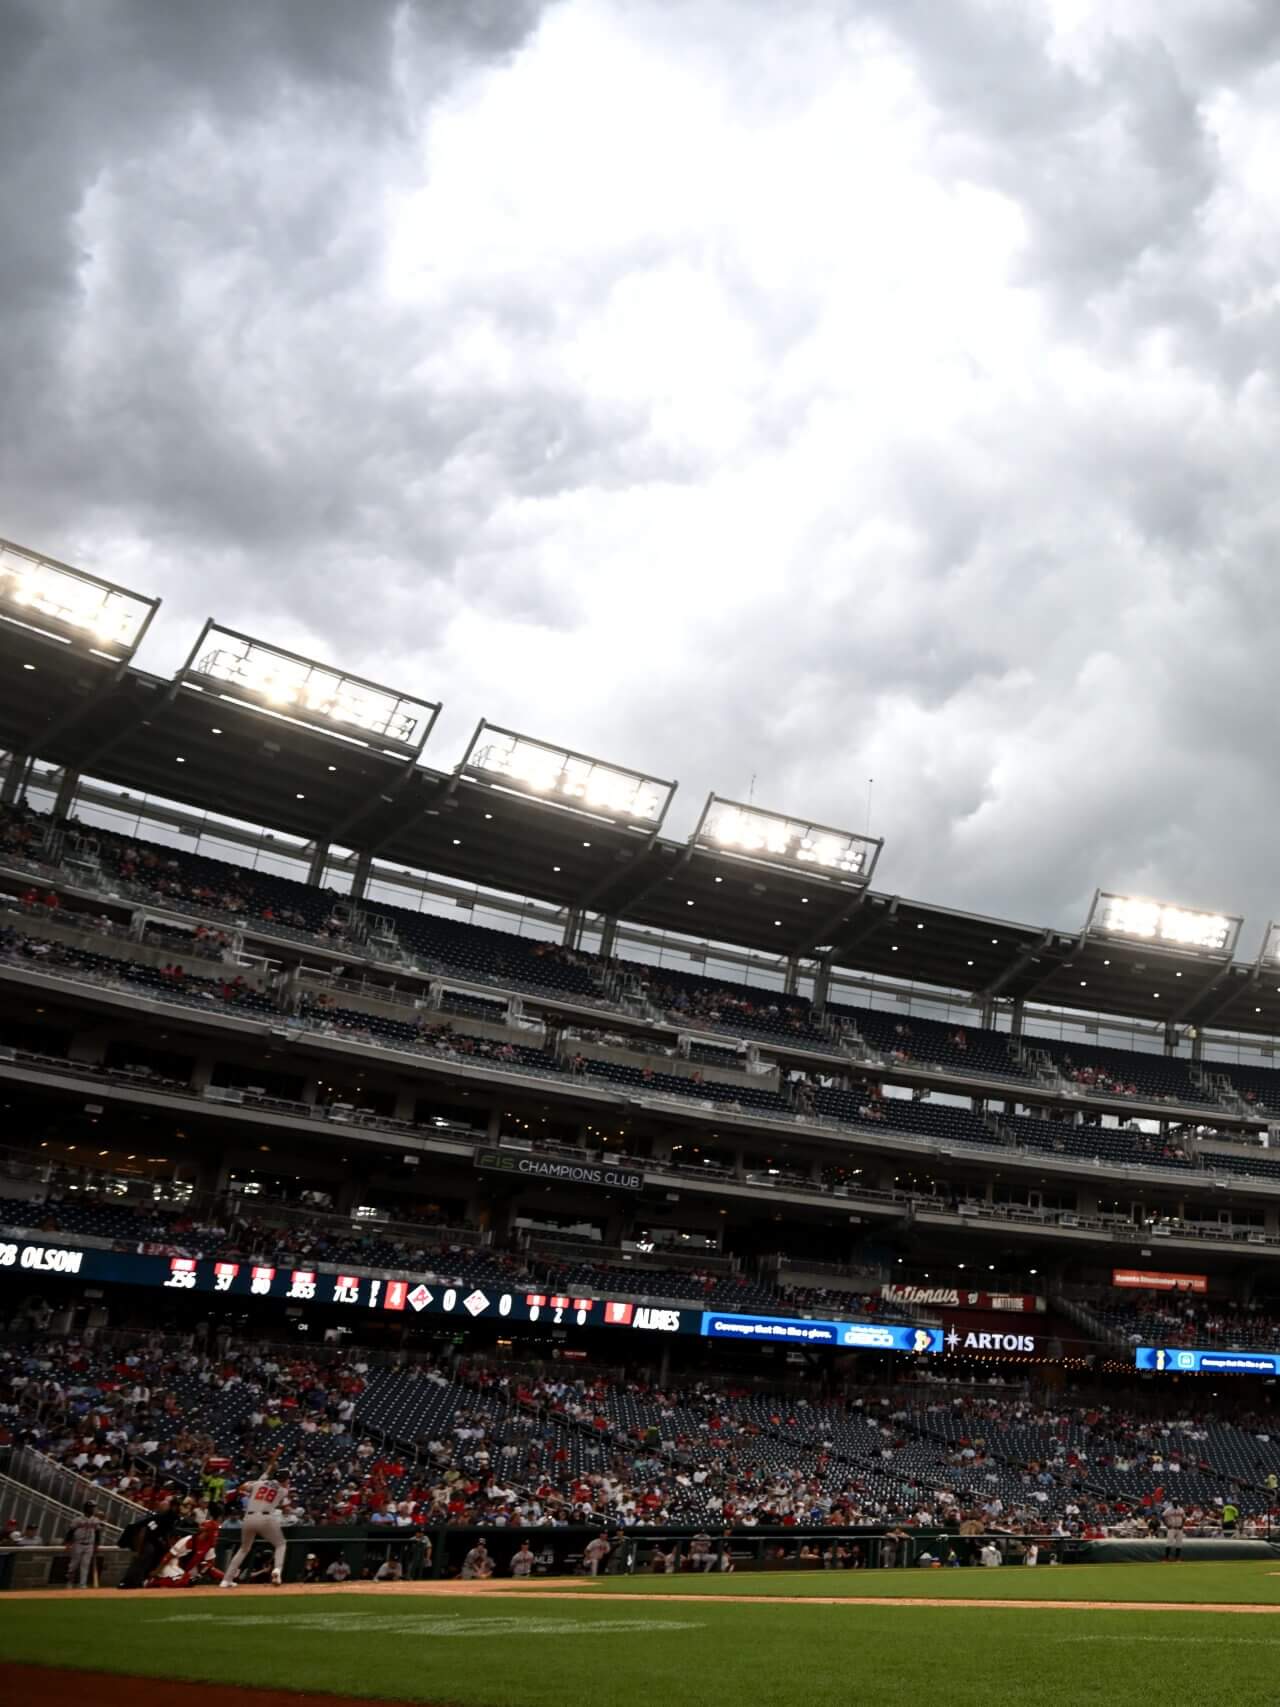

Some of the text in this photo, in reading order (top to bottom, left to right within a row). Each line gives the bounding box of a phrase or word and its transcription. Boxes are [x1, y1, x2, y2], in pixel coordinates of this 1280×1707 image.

[518, 1159, 602, 1183] CHAMPIONS
[604, 1171, 641, 1188] CLUB
[21, 1246, 83, 1273] OLSON
[443, 1289, 456, 1311] 0
[499, 1294, 512, 1316] 0
[880, 1284, 960, 1307] Nationals
[715, 1321, 754, 1334] Coverage
[754, 1324, 772, 1334] that
[772, 1325, 786, 1335] fits
[787, 1327, 801, 1336] like
[964, 1331, 1035, 1352] ARTOIS
[255, 1486, 278, 1503] 28
